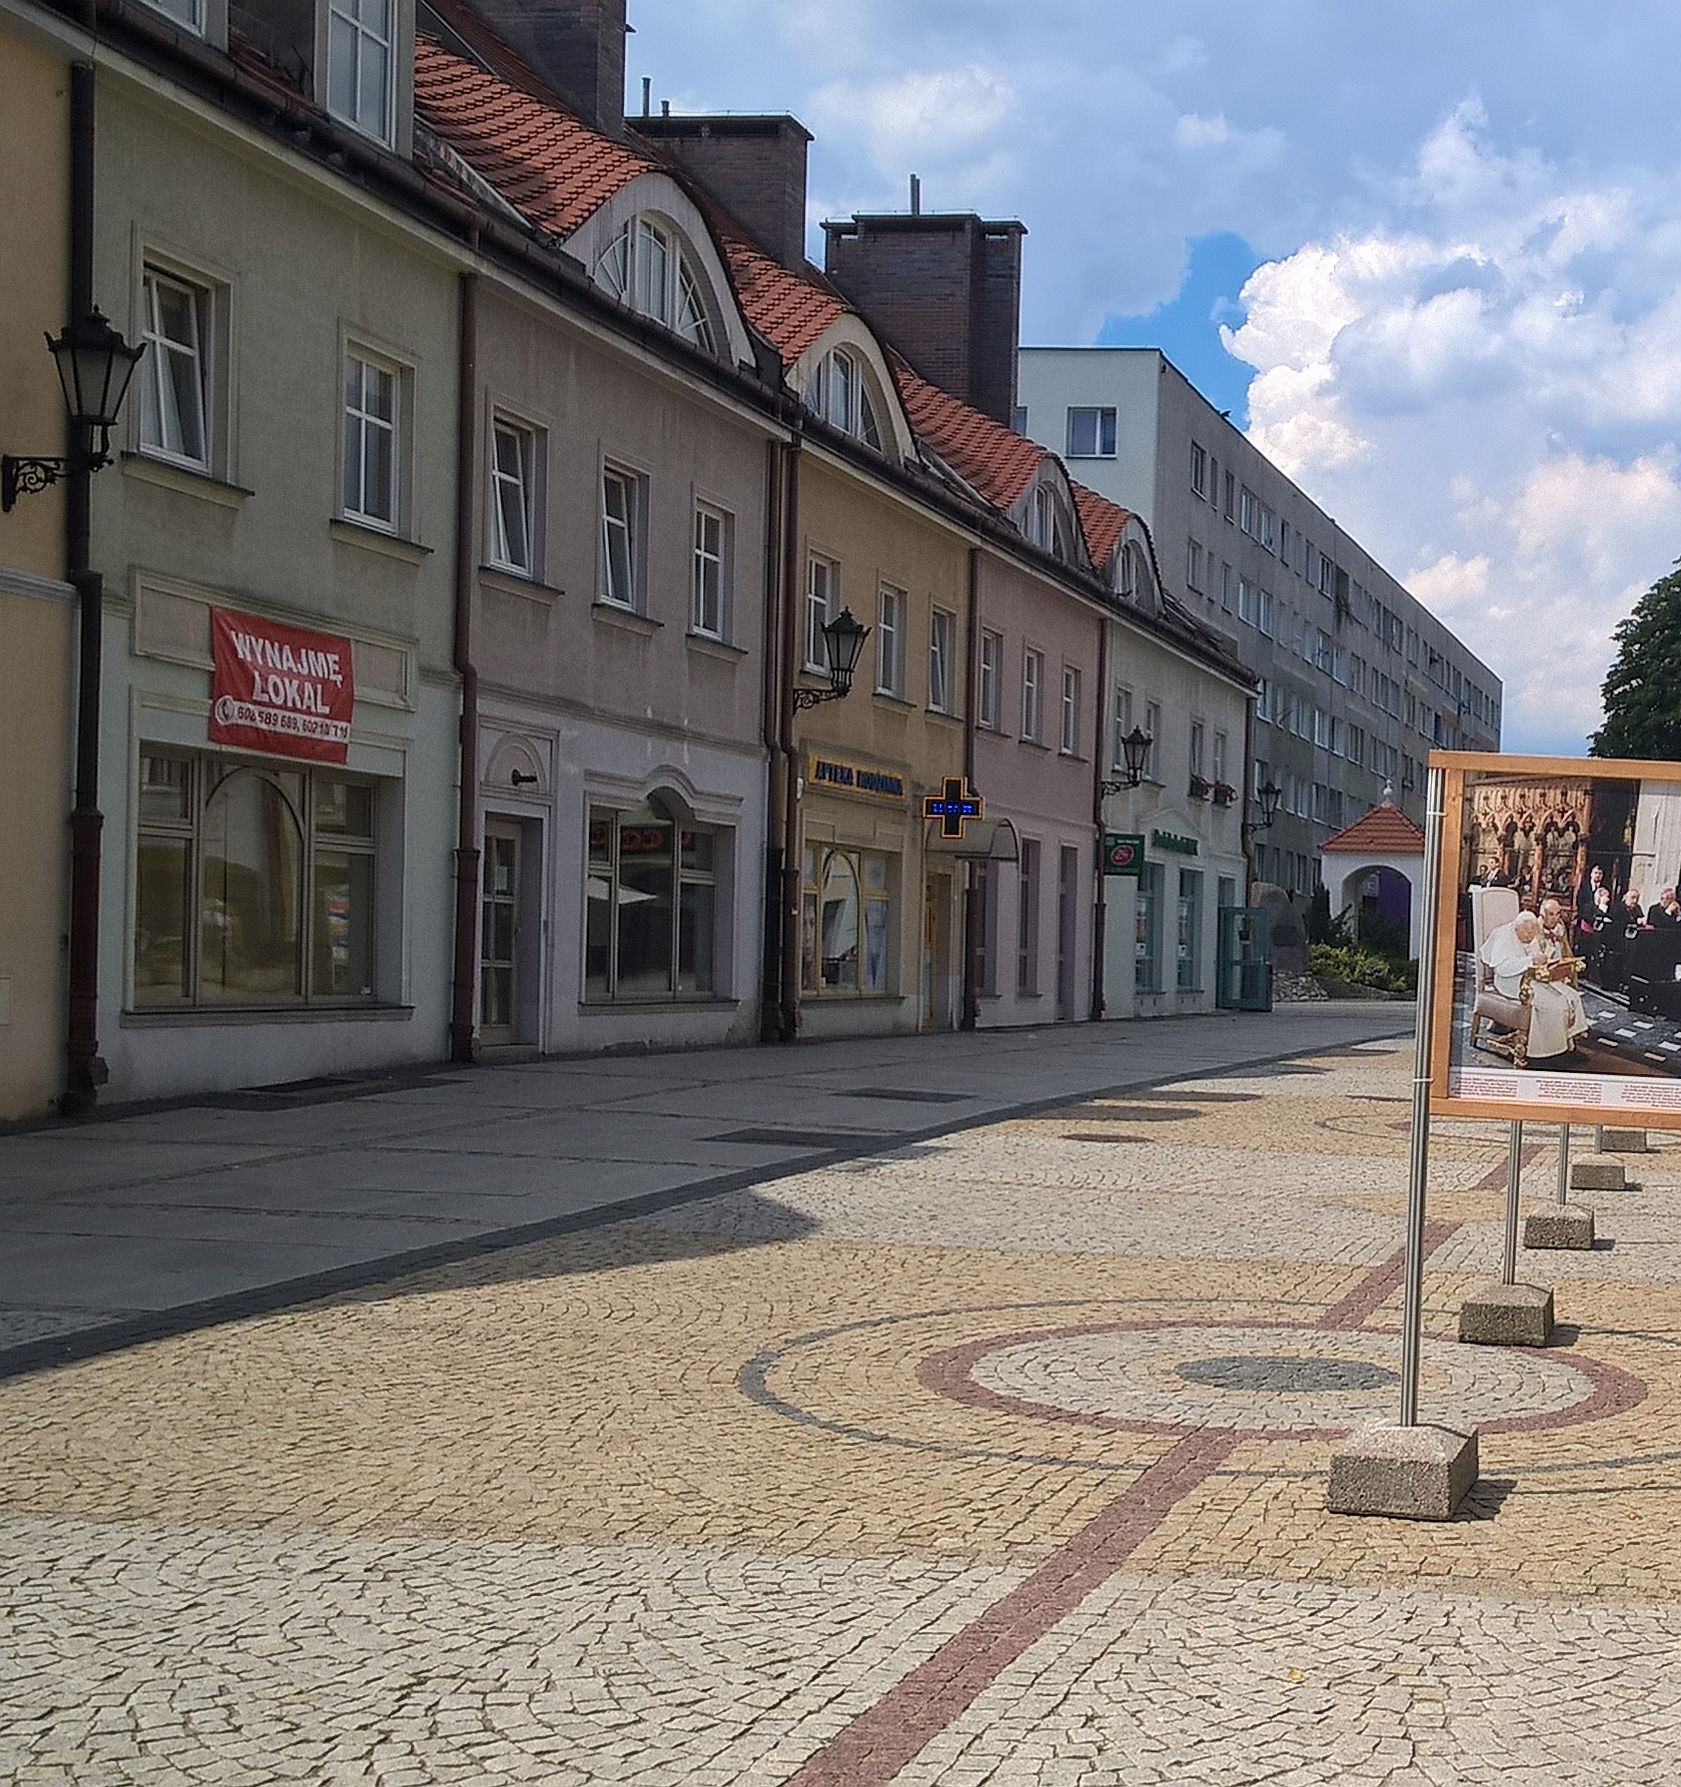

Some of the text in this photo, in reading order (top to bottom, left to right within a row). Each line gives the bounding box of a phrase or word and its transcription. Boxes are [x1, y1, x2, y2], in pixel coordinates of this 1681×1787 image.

[231, 630, 343, 688] WYNAJMĘ
[252, 671, 330, 714] LOKAL
[258, 710, 278, 727] 589
